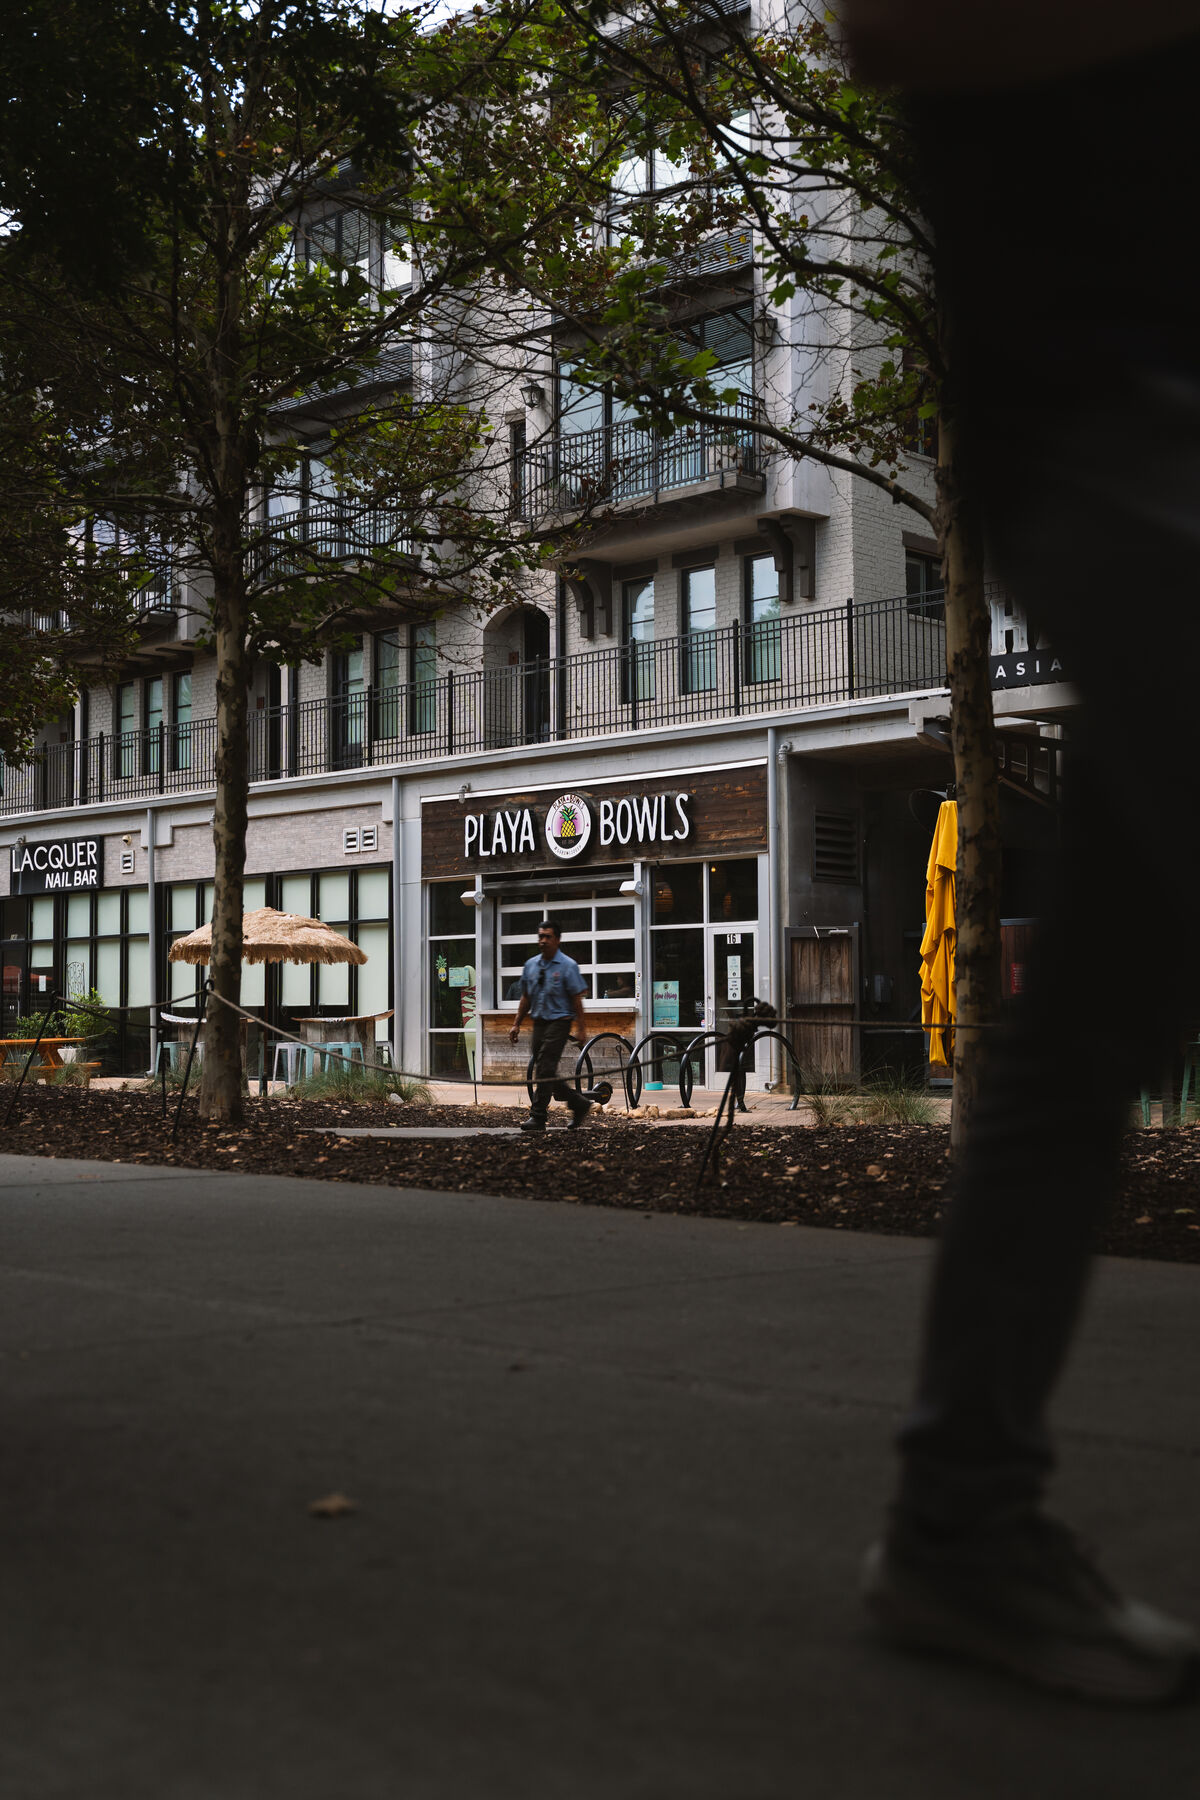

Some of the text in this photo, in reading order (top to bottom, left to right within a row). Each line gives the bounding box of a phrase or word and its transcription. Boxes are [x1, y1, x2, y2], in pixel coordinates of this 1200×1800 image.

[464, 793, 691, 858] PLAYA BOWLS
[12, 840, 97, 873] LACQUER
[45, 868, 97, 889] NAIL BAR
